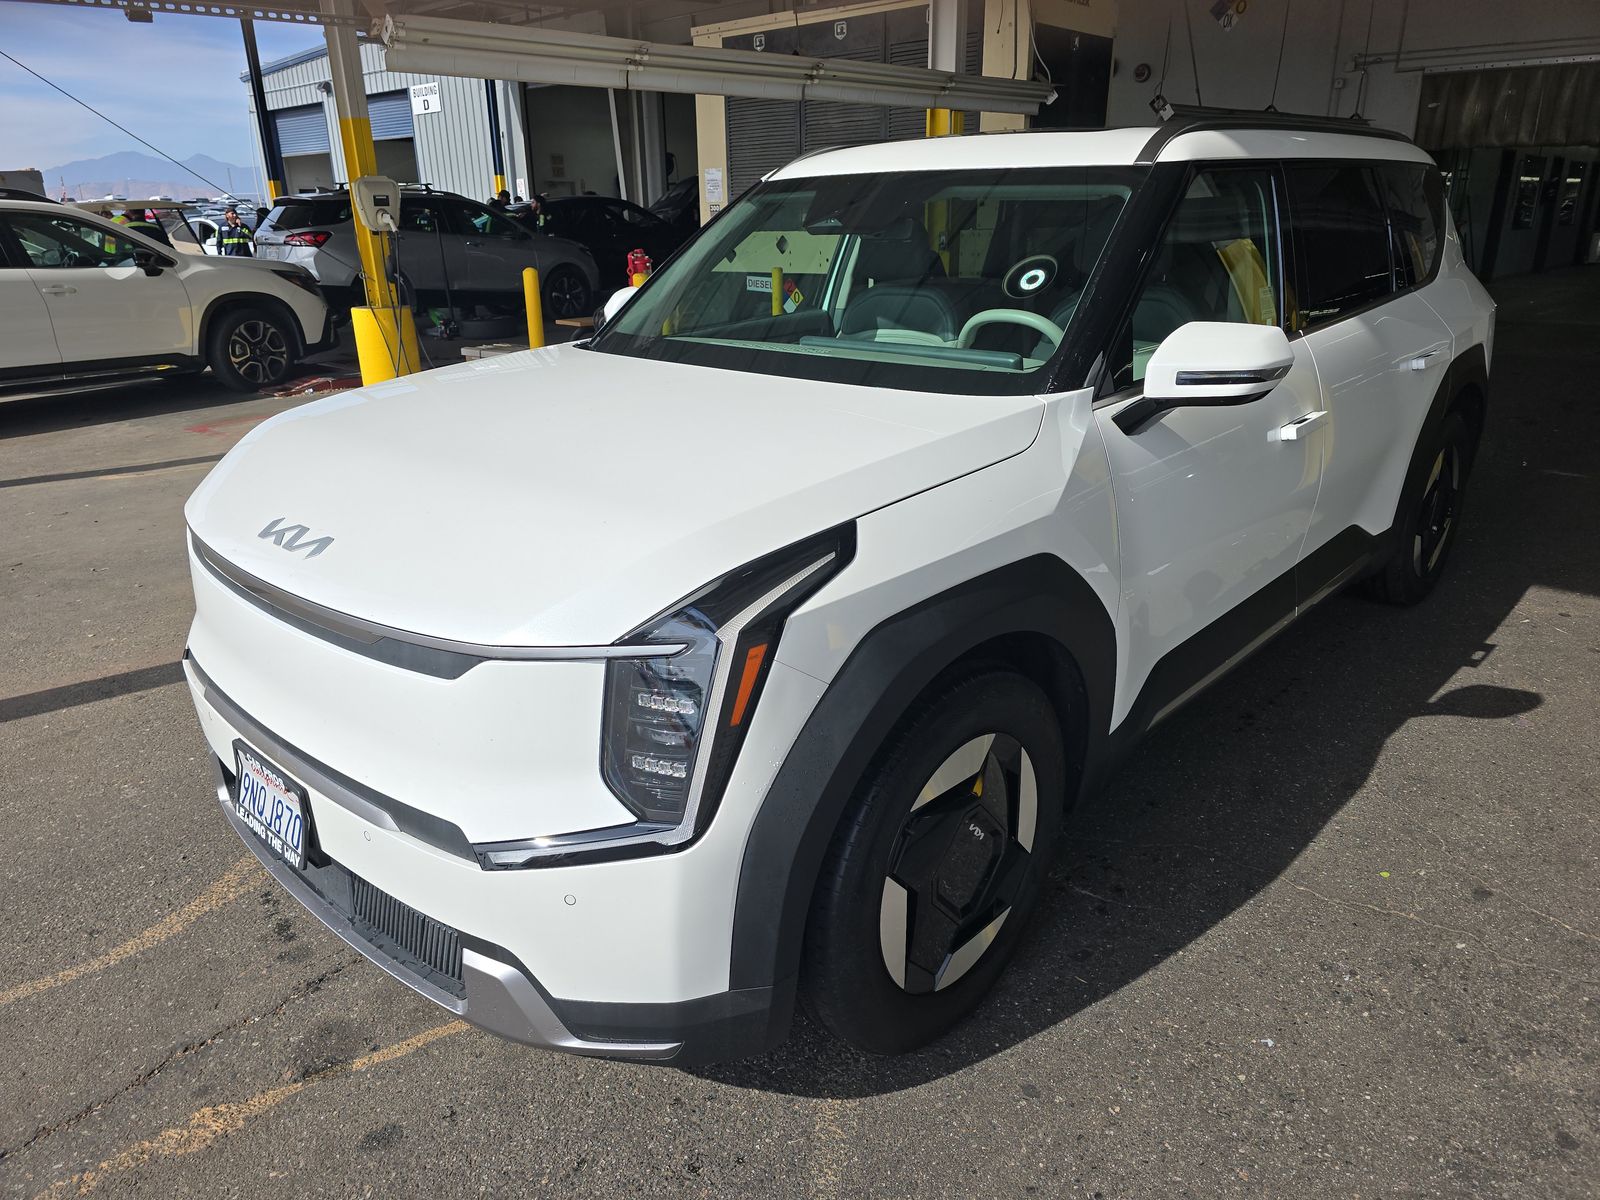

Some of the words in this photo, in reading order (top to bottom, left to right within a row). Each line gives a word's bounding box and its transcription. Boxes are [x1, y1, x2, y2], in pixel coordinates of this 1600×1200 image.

[412, 85, 438, 98] BUILDING
[423, 99, 430, 111] D
[794, 291, 800, 304] 0
[257, 516, 335, 560] KIA
[236, 803, 266, 840] LEADING
[267, 830, 283, 854] THE
[284, 845, 301, 868] WAY
[969, 823, 985, 840] KIA
